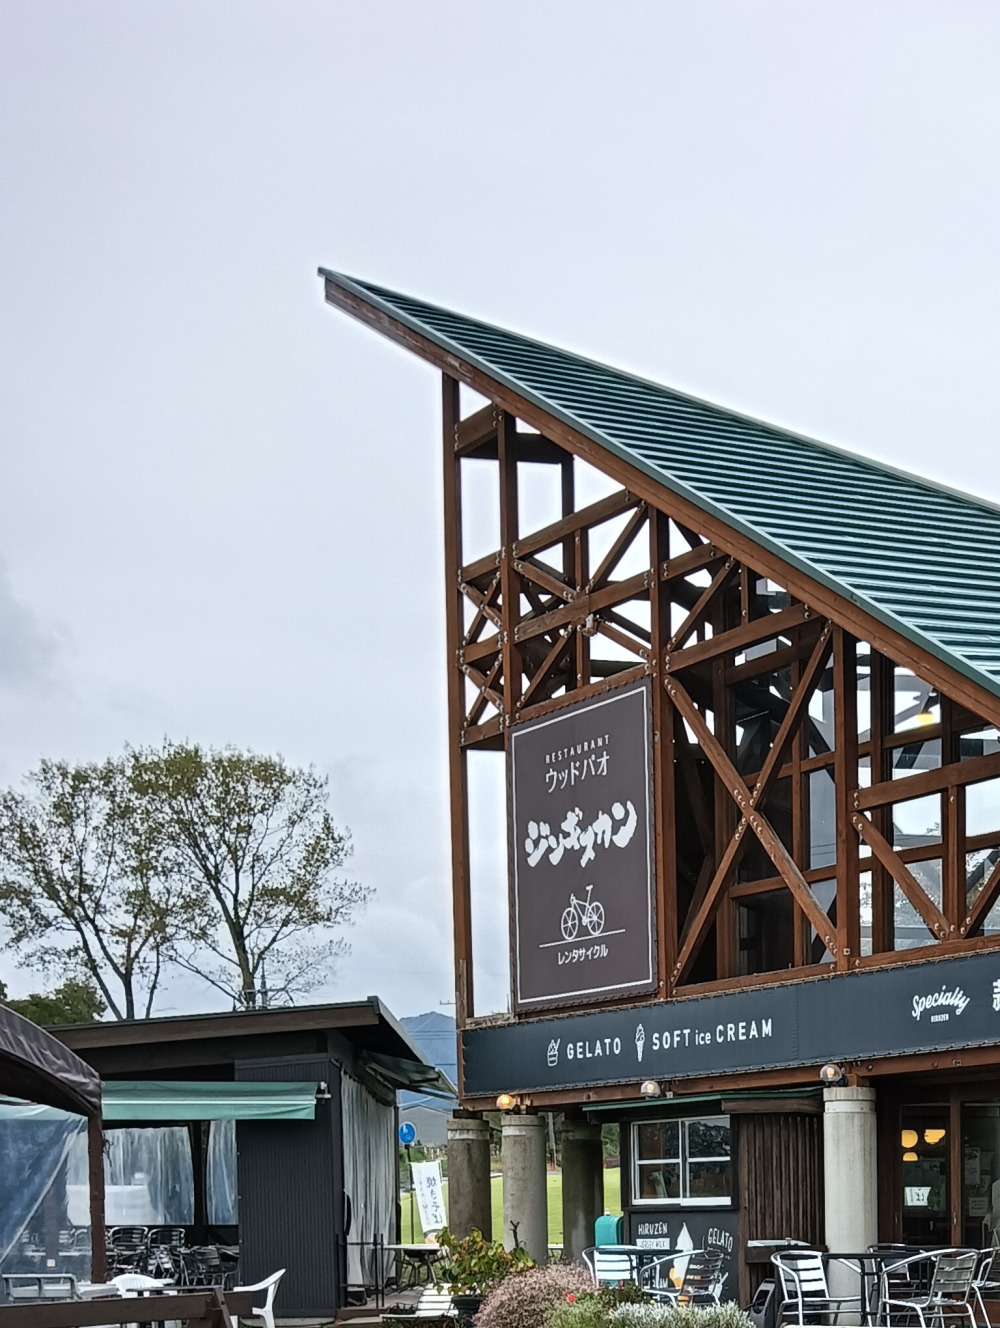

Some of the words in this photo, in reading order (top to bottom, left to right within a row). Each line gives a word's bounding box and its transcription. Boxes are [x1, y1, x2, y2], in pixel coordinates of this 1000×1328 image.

[545, 734, 611, 764] RESTAURANT
[545, 751, 611, 794] ウッドパオ
[524, 799, 638, 868] ジンギスカン
[557, 943, 609, 966] レンタサイクル
[911, 984, 971, 1022] Specialty
[566, 1036, 622, 1061] GELATO
[652, 1028, 690, 1052] SOFT
[695, 1029, 712, 1047] ice
[715, 1018, 774, 1044] CREAM
[637, 1221, 669, 1236] HIRUZEN
[707, 1227, 734, 1253] GELATO
